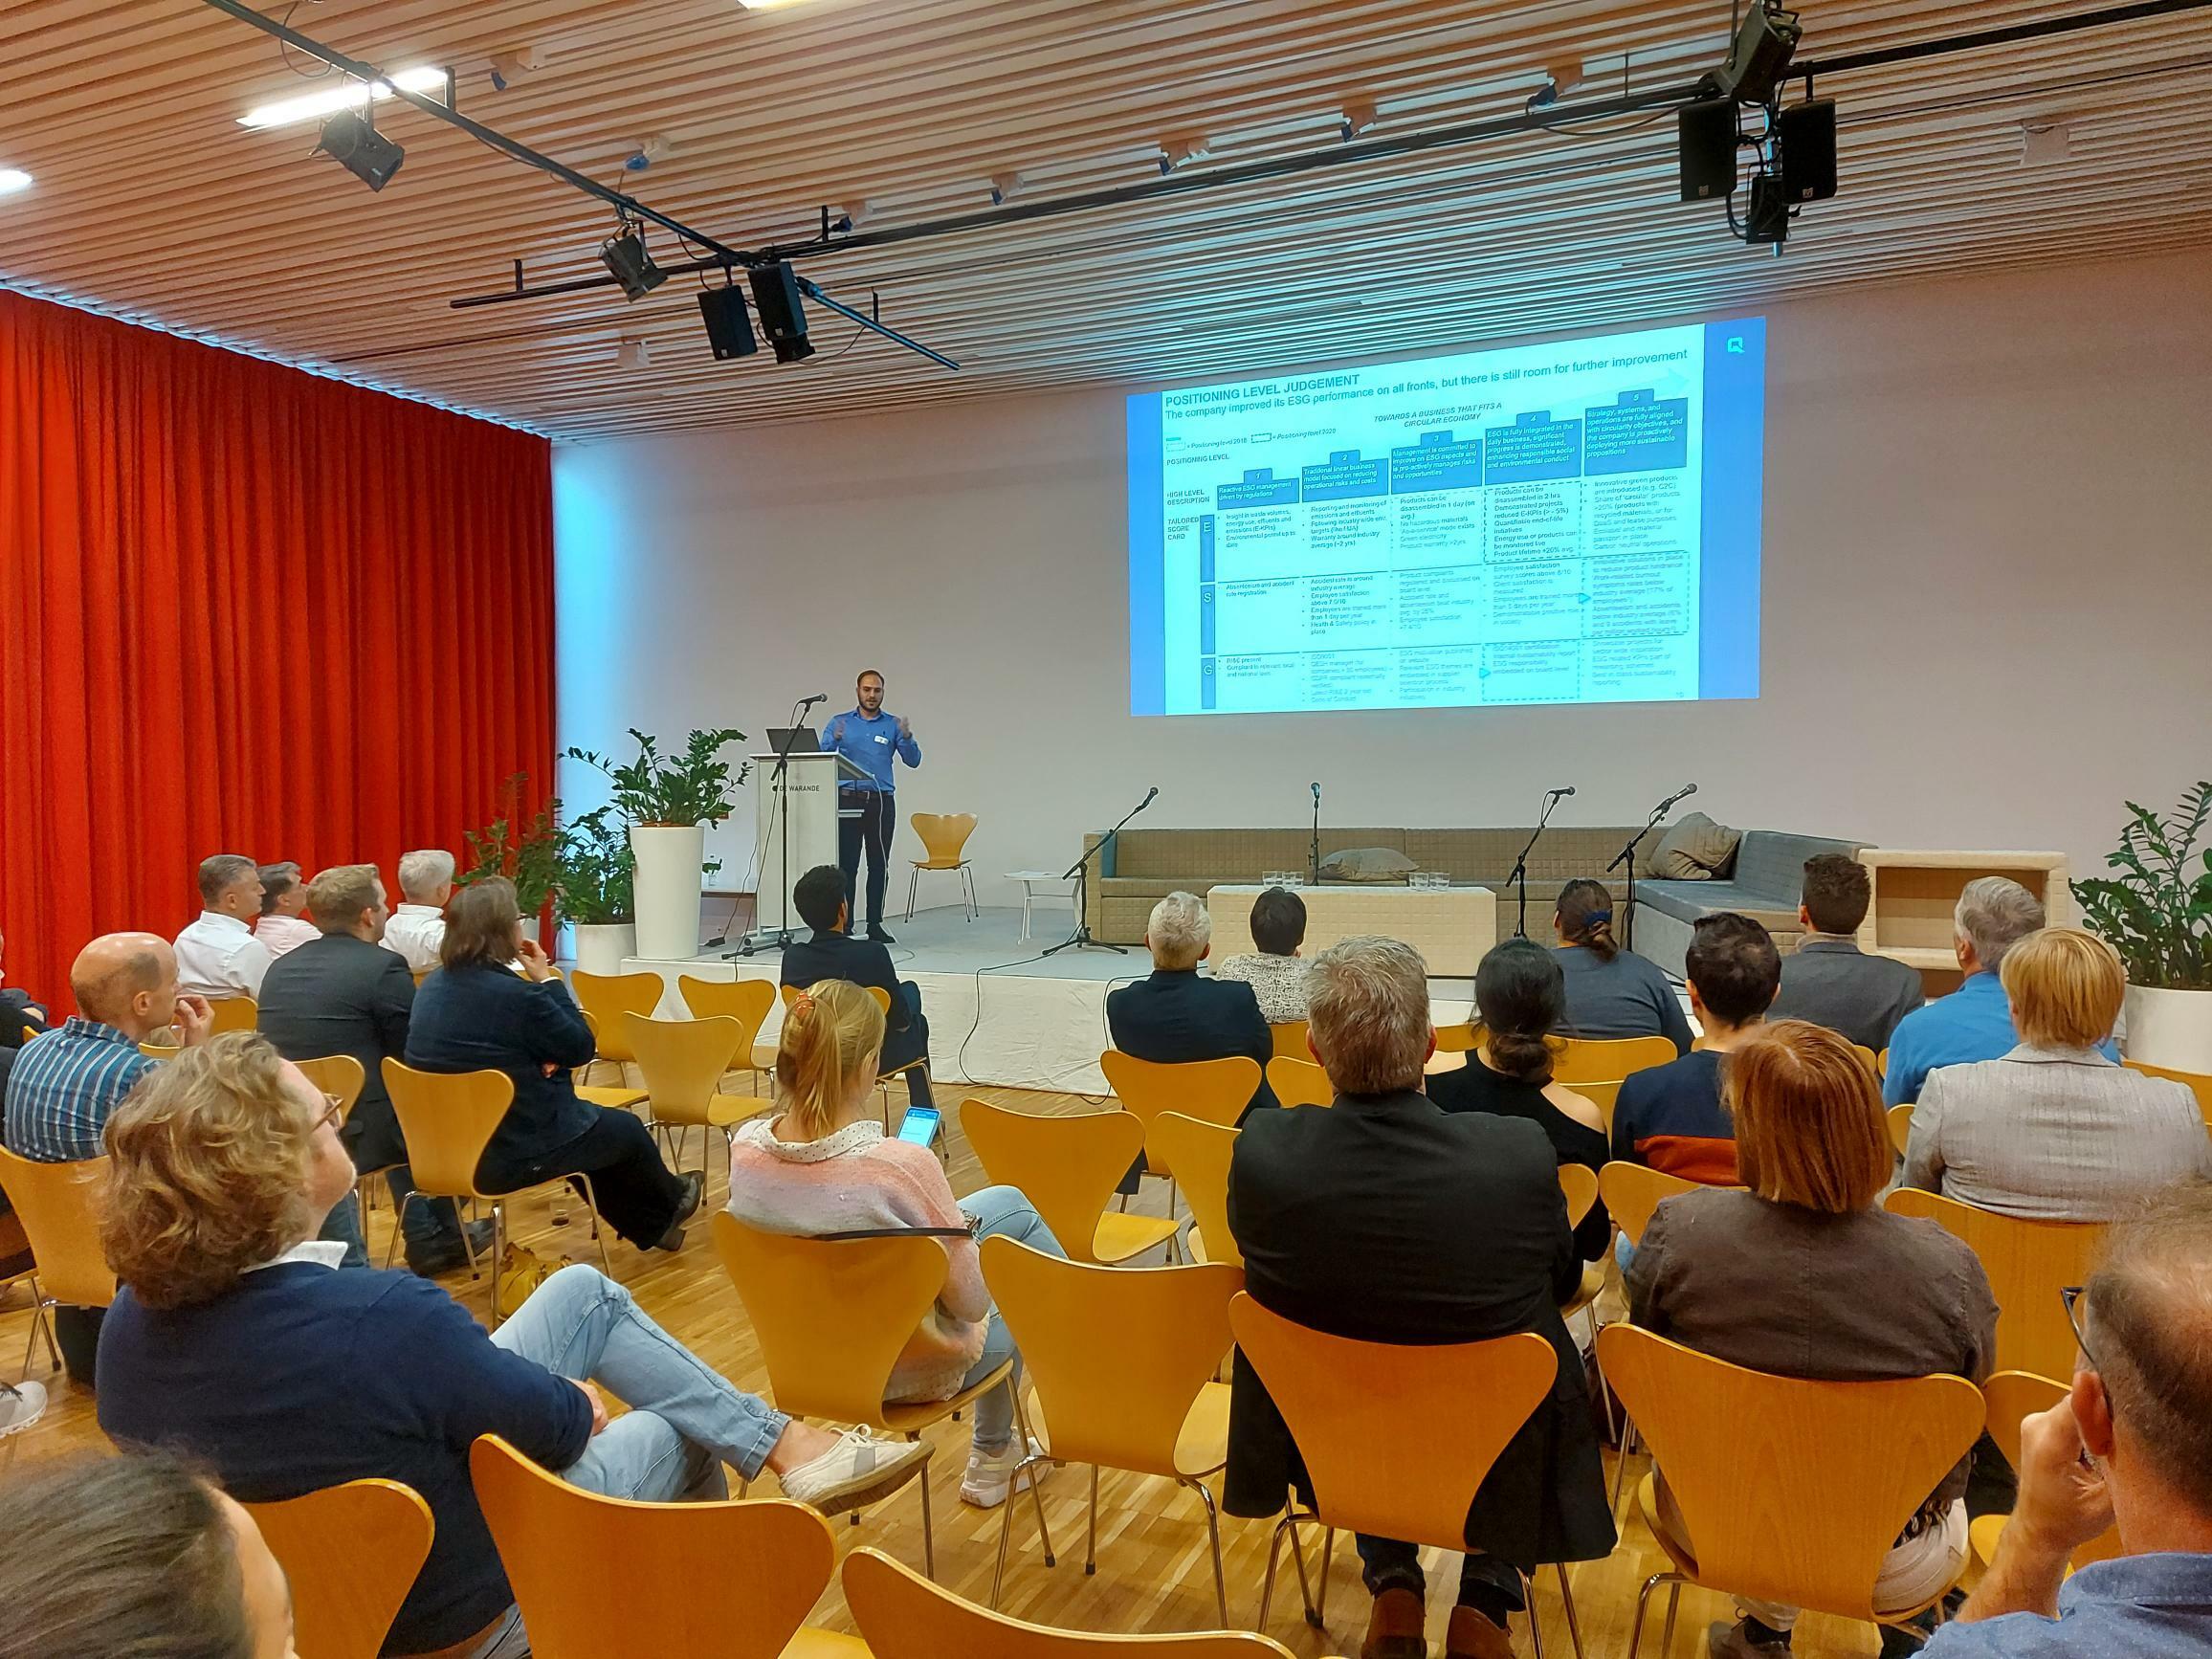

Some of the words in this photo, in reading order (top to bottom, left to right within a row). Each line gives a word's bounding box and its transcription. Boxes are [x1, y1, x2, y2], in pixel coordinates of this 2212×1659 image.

[1165, 409, 1182, 419] The
[1184, 406, 1226, 419] company
[1229, 399, 1271, 413] improved
[1274, 397, 1284, 406] its
[1288, 394, 1310, 405] ESG
[1313, 387, 1373, 404] performance
[1393, 383, 1404, 392] all
[1406, 379, 1437, 393] fronts,
[1441, 376, 1457, 387] but
[1461, 372, 1487, 385] there
[1491, 371, 1498, 381] is
[1503, 368, 1519, 379] still
[1523, 367, 1551, 377] room
[1554, 363, 1569, 373] for
[1573, 358, 1608, 371] further
[1612, 348, 1687, 368] improvement
[1165, 388, 1239, 407] POSITIONING
[1243, 384, 1280, 397] LEVEL
[1284, 373, 1359, 392] JUDGEMENT
[1374, 412, 1409, 422] TOWARDS
[1419, 408, 1454, 417] BUSINESS
[1405, 417, 1441, 427] CIRCULAR
[1443, 413, 1480, 422] ECONOMY
[1587, 416, 1623, 426] operations
[1649, 410, 1673, 419] aligned
[1166, 455, 1207, 465] POSITIONING
[1167, 497, 1209, 505] DESCRIPTION
[1204, 521, 1211, 531] E
[1204, 592, 1210, 602] S
[1204, 665, 1212, 675] G
